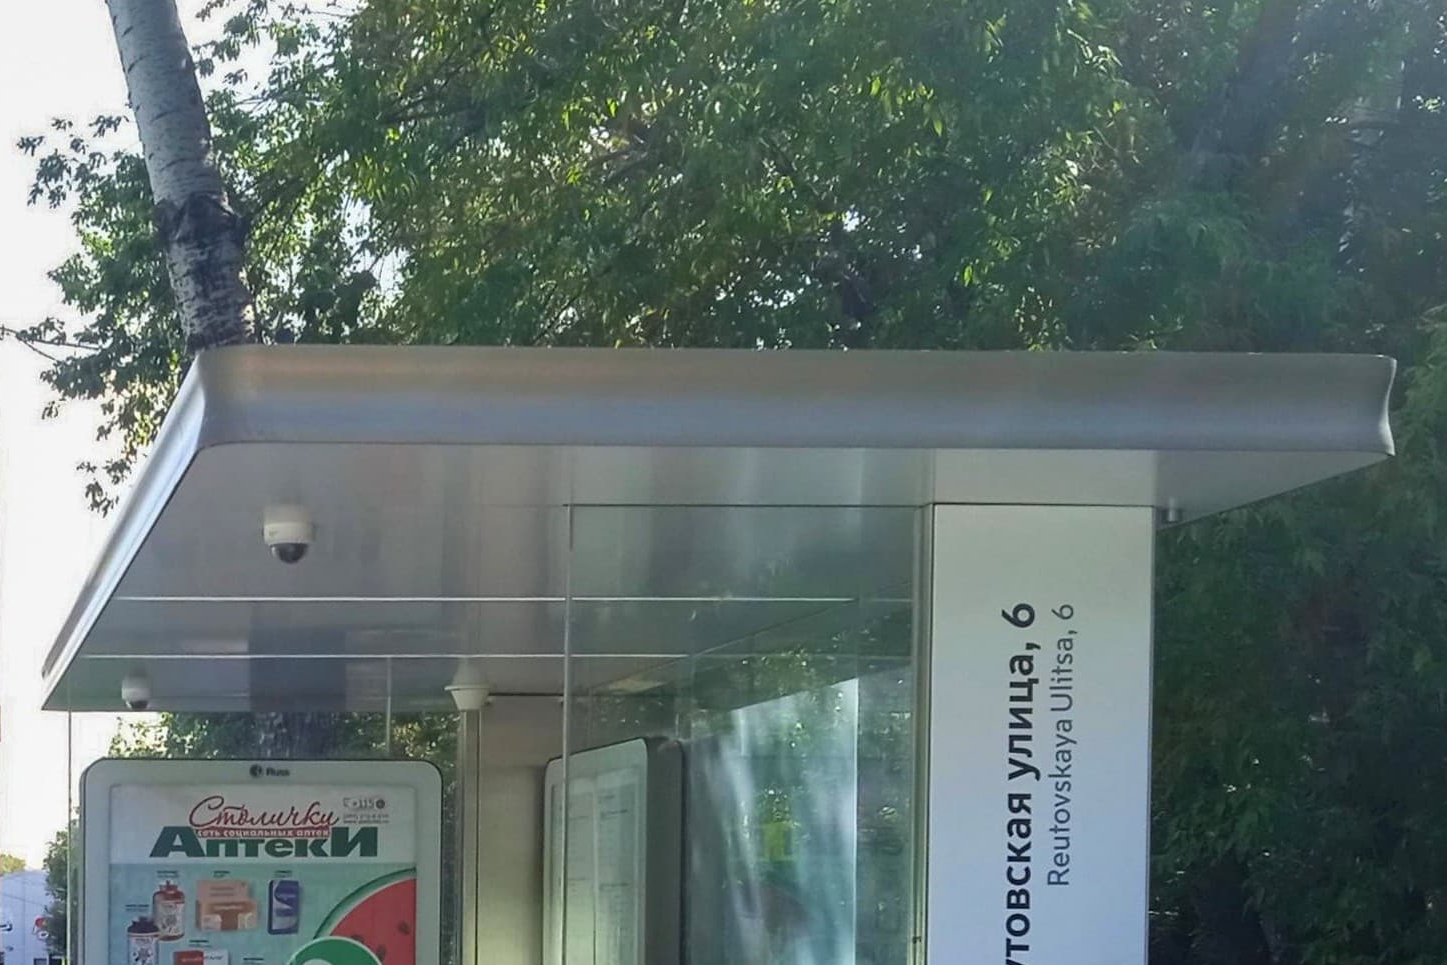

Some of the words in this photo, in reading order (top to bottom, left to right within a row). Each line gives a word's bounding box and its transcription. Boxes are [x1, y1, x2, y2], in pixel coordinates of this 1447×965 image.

[1002, 602, 1036, 628] 6
[1051, 603, 1074, 620] 6
[1050, 630, 1079, 711] Ulitsa,
[1007, 642, 1041, 781] улица,
[189, 795, 339, 829] Столички
[1047, 717, 1078, 886] Reutovskaya
[223, 829, 294, 839] социальных
[296, 828, 330, 838] аптек
